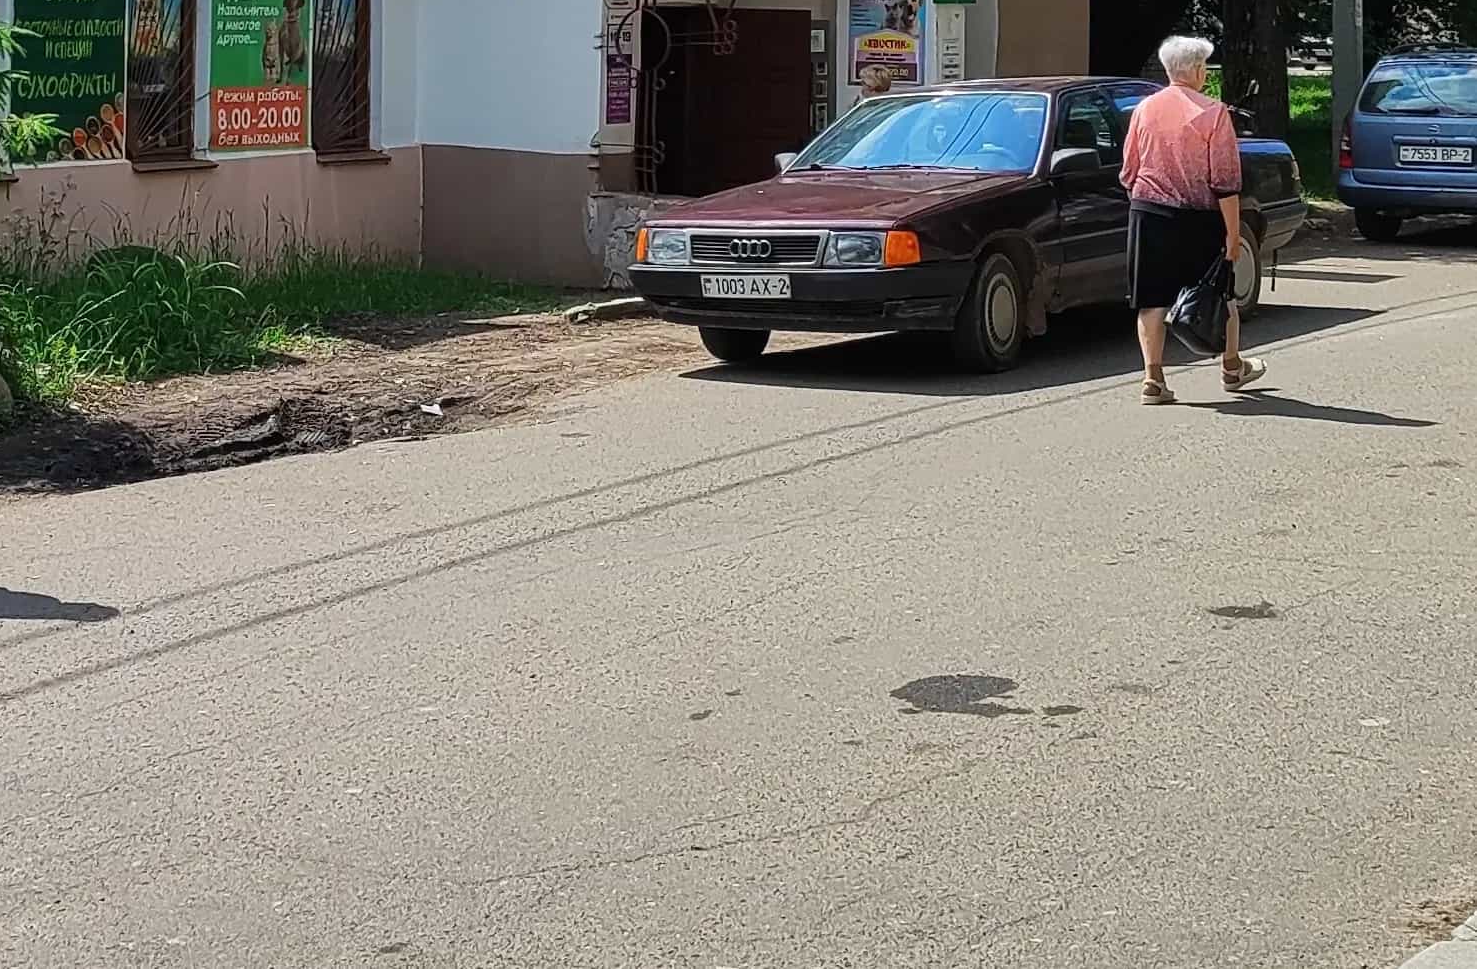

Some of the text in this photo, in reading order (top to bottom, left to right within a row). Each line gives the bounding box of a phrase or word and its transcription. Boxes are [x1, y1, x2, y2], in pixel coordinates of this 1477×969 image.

[217, 3, 280, 17] Наполнитель
[74, 17, 123, 38] СЛАДОСТИ
[225, 20, 261, 31] многое
[45, 39, 92, 61] И СПЕЦИИ
[17, 72, 116, 99] СУХОФРУКТЫ
[217, 89, 255, 103] Режим
[217, 105, 301, 130] 8.00-20.00
[218, 130, 300, 146] без выходных
[1410, 147, 1437, 160] 7553
[715, 277, 788, 295] 1003 AX-2
